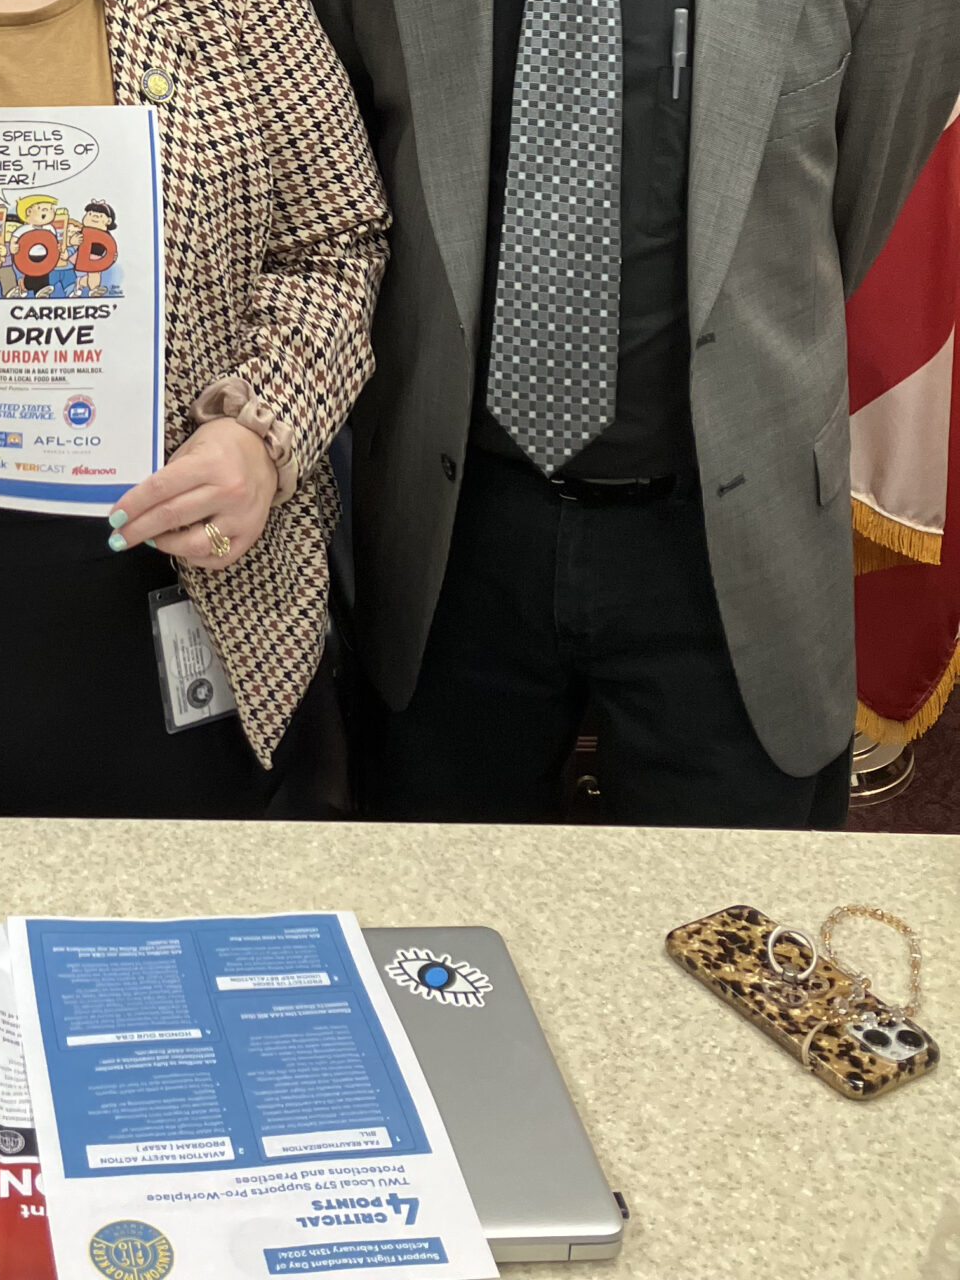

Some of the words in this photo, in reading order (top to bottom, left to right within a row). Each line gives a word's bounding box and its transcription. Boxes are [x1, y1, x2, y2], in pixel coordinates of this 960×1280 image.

[2, 130, 63, 142] SPELLS
[18, 144, 65, 156] LOTS
[73, 143, 95, 155] OF
[33, 159, 71, 171] THIS
[10, 304, 118, 321] CARRIERS'
[5, 325, 95, 346] DRIVE
[53, 350, 69, 363] IN
[72, 349, 103, 363] MAY
[21, 404, 51, 412] STATES
[34, 436, 101, 446] AFL-CIO
[142, 1144, 167, 1152] ASAP
[175, 1141, 226, 1151] PROGRAM
[281, 1140, 362, 1153] REAUTHORIZATION
[363, 1139, 379, 1147] FAA
[99, 1156, 138, 1165] ACTION
[141, 1154, 176, 1162] SAFETY
[179, 1150, 226, 1160] AVIATION
[300, 1169, 325, 1180] and
[327, 1164, 405, 1178] Protections
[235, 1173, 298, 1186] Practices
[339, 1178, 375, 1189] Local
[378, 1176, 409, 1188] TWU
[250, 1181, 312, 1197] Supports
[315, 1180, 337, 1191] 579
[146, 1186, 248, 1203] Pro-Workplace
[311, 1196, 384, 1212] POINTS
[385, 1192, 420, 1226] 4
[295, 1211, 388, 1228] CRITICAL
[332, 1243, 379, 1256] February
[380, 1243, 394, 1251] on
[395, 1241, 429, 1252] Action
[277, 1249, 307, 1260] 2024!
[309, 1247, 331, 1258] 13th
[397, 1251, 441, 1262] Support
[292, 1259, 309, 1271] Day
[310, 1256, 364, 1269] Attendant
[366, 1254, 396, 1265] Flight
[275, 1261, 290, 1272] of
